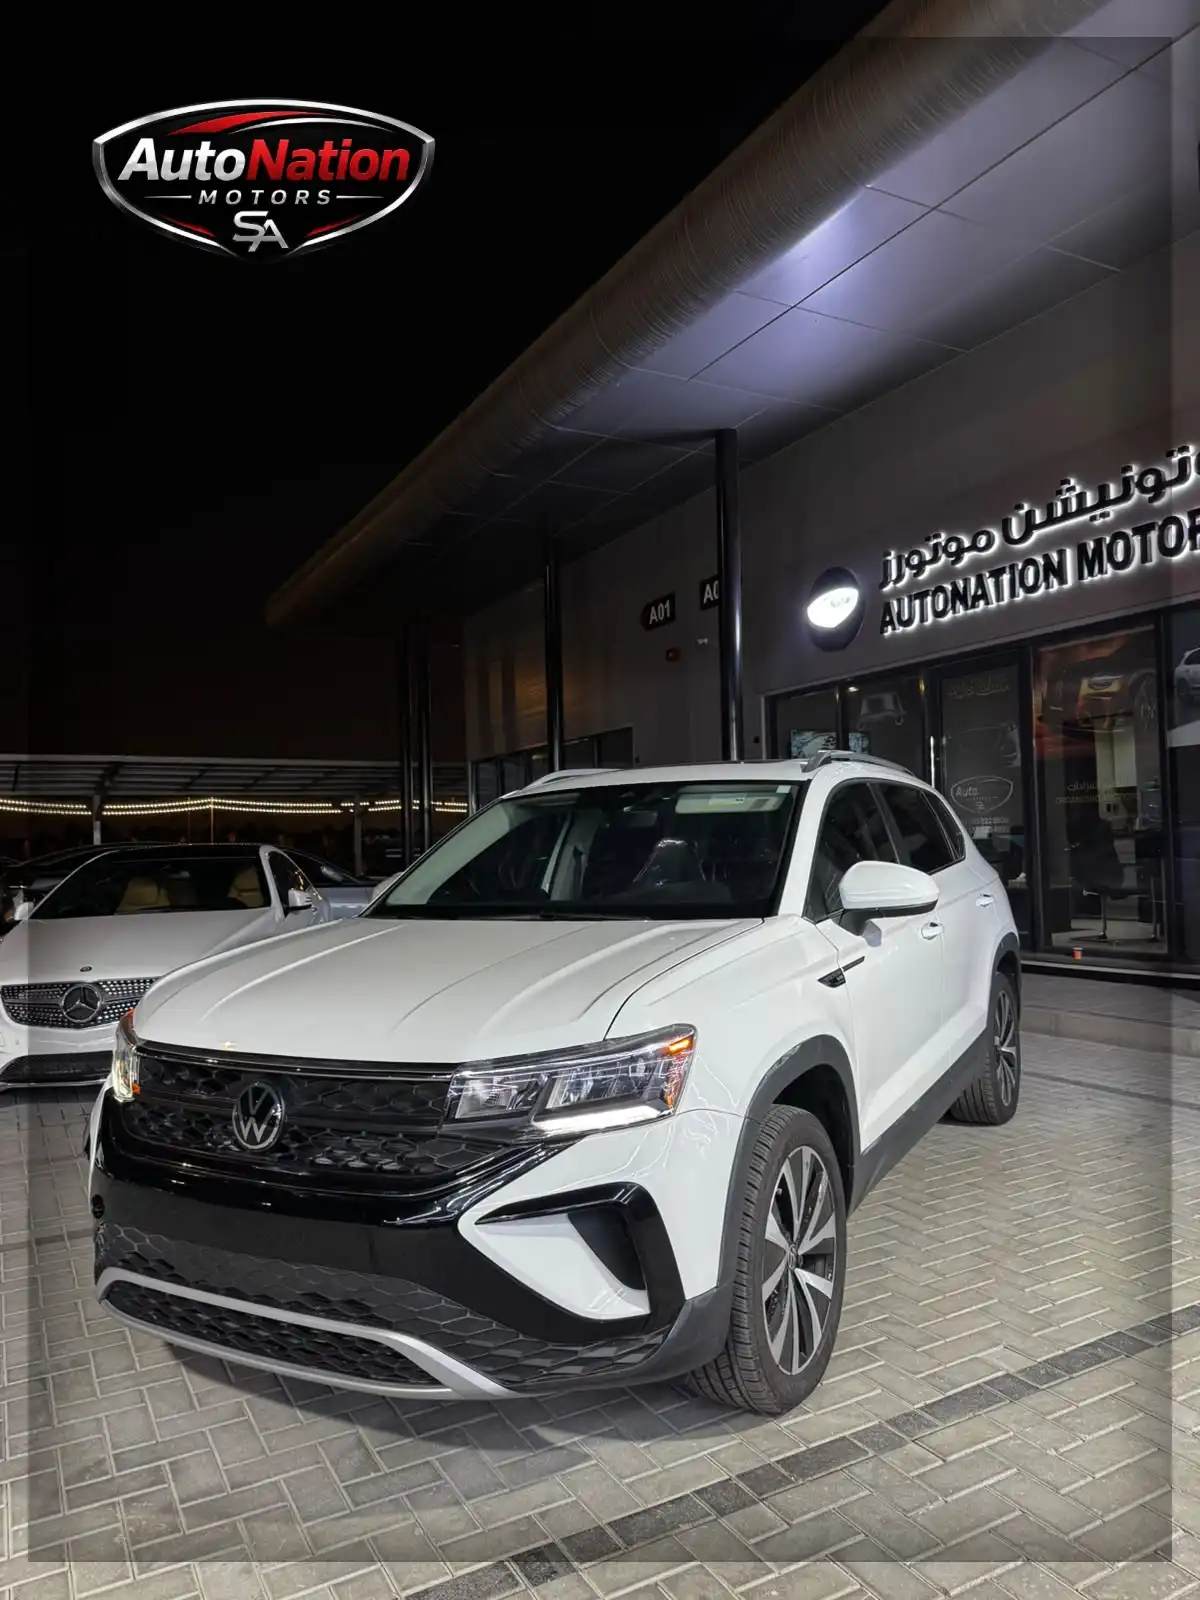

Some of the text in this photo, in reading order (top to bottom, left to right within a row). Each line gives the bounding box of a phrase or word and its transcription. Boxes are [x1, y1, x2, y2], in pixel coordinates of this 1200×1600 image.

[879, 444, 1200, 591] تونيشن موتورز
[649, 599, 671, 625] A01
[879, 548, 1070, 635] AUTONATION
